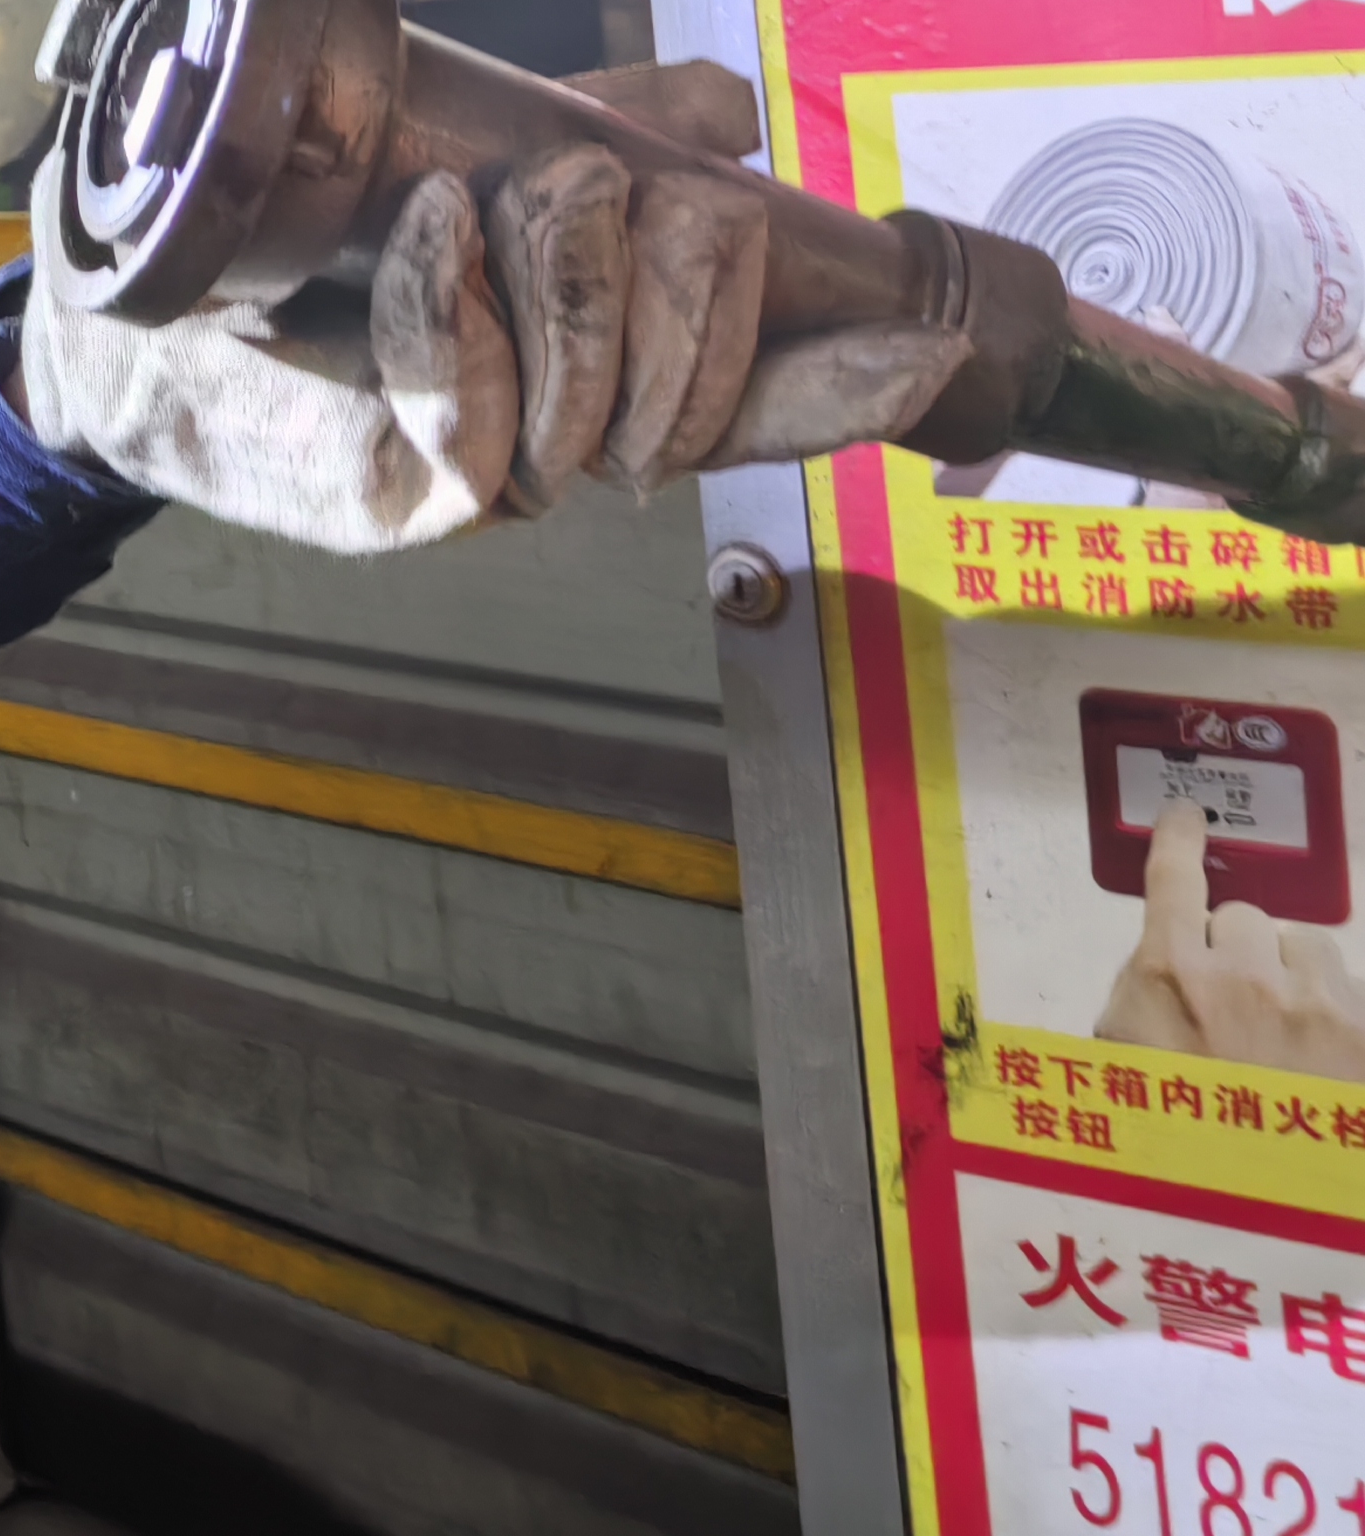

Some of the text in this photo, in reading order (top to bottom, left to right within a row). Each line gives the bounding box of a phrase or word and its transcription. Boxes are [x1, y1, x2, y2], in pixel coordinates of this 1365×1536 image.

[948, 513, 1365, 577] 打开或击碎箱
[955, 563, 1338, 630] 取出消防水带
[1013, 1097, 1116, 1152] 按钮
[1017, 1233, 1365, 1385] 火警电
